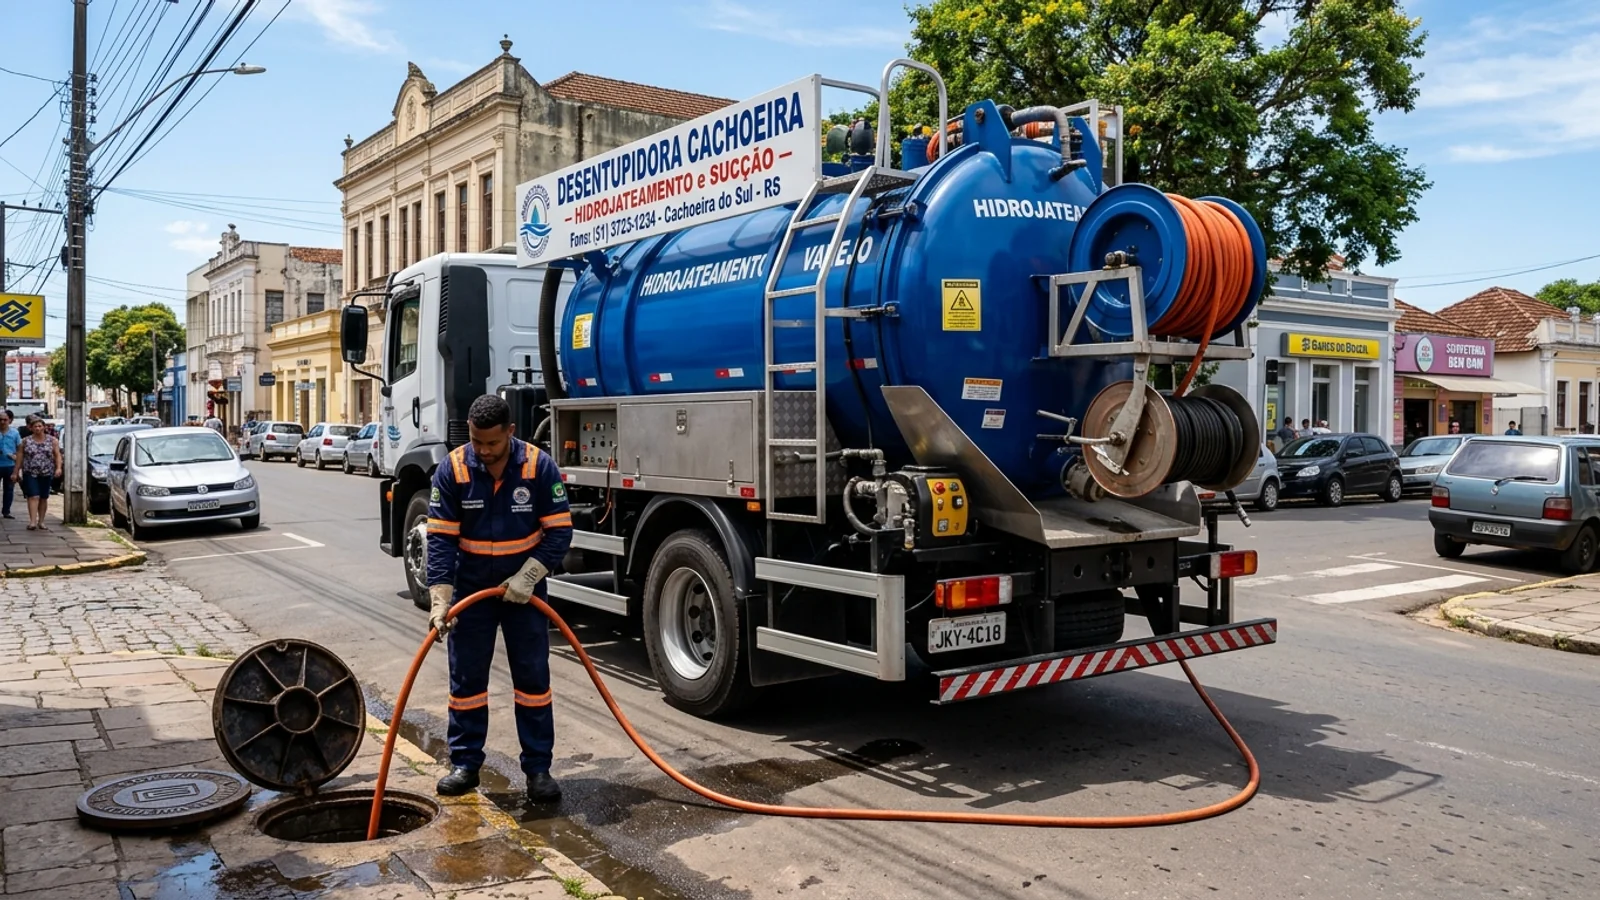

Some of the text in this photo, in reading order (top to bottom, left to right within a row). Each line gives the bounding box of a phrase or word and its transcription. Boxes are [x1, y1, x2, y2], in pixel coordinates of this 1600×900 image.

[557, 135, 683, 206] DESENTUPIDORA
[687, 91, 805, 164] CACHOEIRA
[575, 172, 693, 225] HIDROJATEAMENTO
[697, 173, 706, 189] e
[709, 146, 774, 185] SUCÇÃO
[664, 196, 716, 223] Cachoeira
[718, 191, 732, 210] do
[735, 183, 753, 206] Sul
[764, 176, 781, 198] RS
[973, 199, 1088, 222] HIDROJATEA
[803, 236, 874, 272] VAEJO
[935, 624, 1002, 649] JKY-4C18
